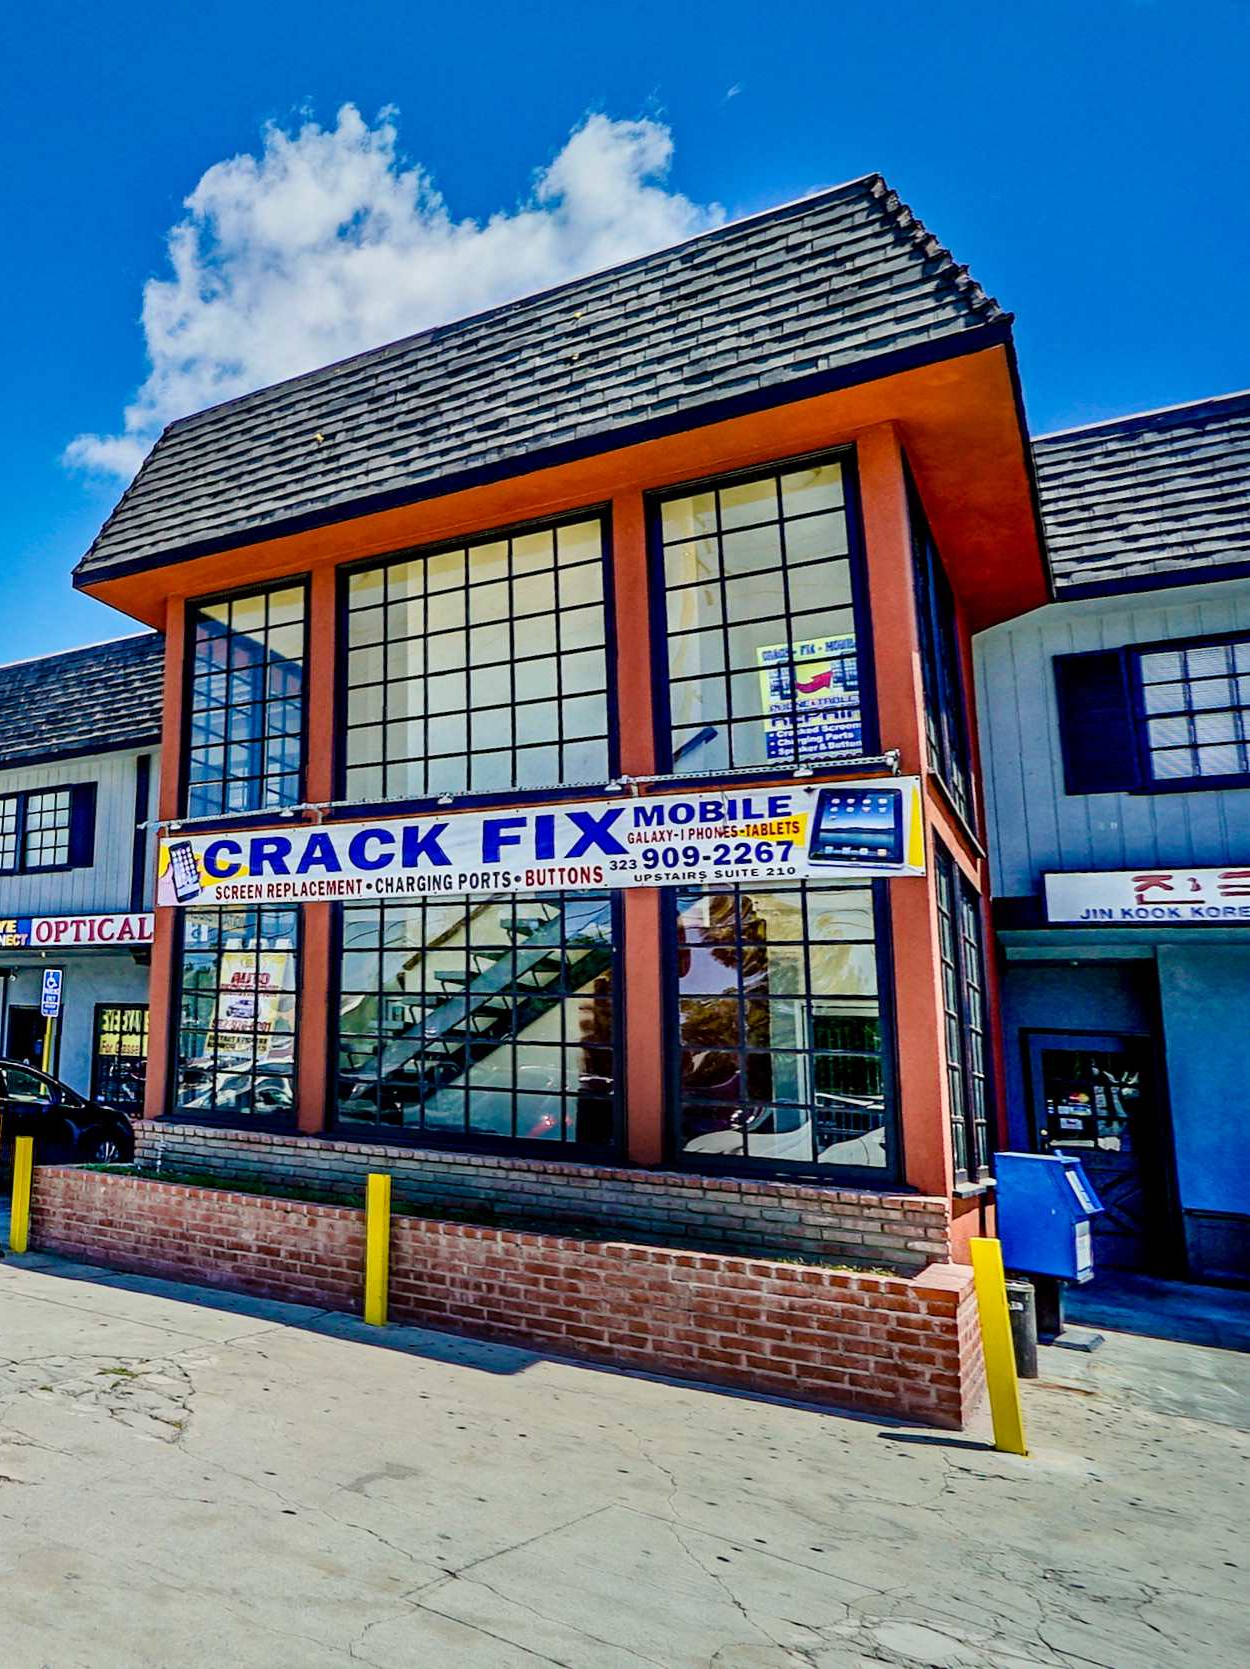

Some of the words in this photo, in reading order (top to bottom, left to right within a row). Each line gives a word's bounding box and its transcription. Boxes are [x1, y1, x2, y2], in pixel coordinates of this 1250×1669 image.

[633, 795, 792, 827] MOBILE
[203, 823, 452, 878] CRACK
[482, 807, 630, 864] FIX
[609, 859, 638, 871] 323
[642, 840, 794, 870] 909-2267
[215, 883, 263, 900] SCREEN
[267, 879, 363, 898] REPLACEMENT
[376, 874, 452, 894] CHARGING
[458, 871, 511, 890] PORTS
[525, 865, 603, 886] BUTTONS
[634, 870, 707, 882] UPSTAIRS
[714, 868, 759, 879] SUITE
[766, 866, 796, 876] 210
[1080, 907, 1113, 920] JIN
[1120, 906, 1181, 919] KOOK
[35, 917, 153, 943] OPTICAL
